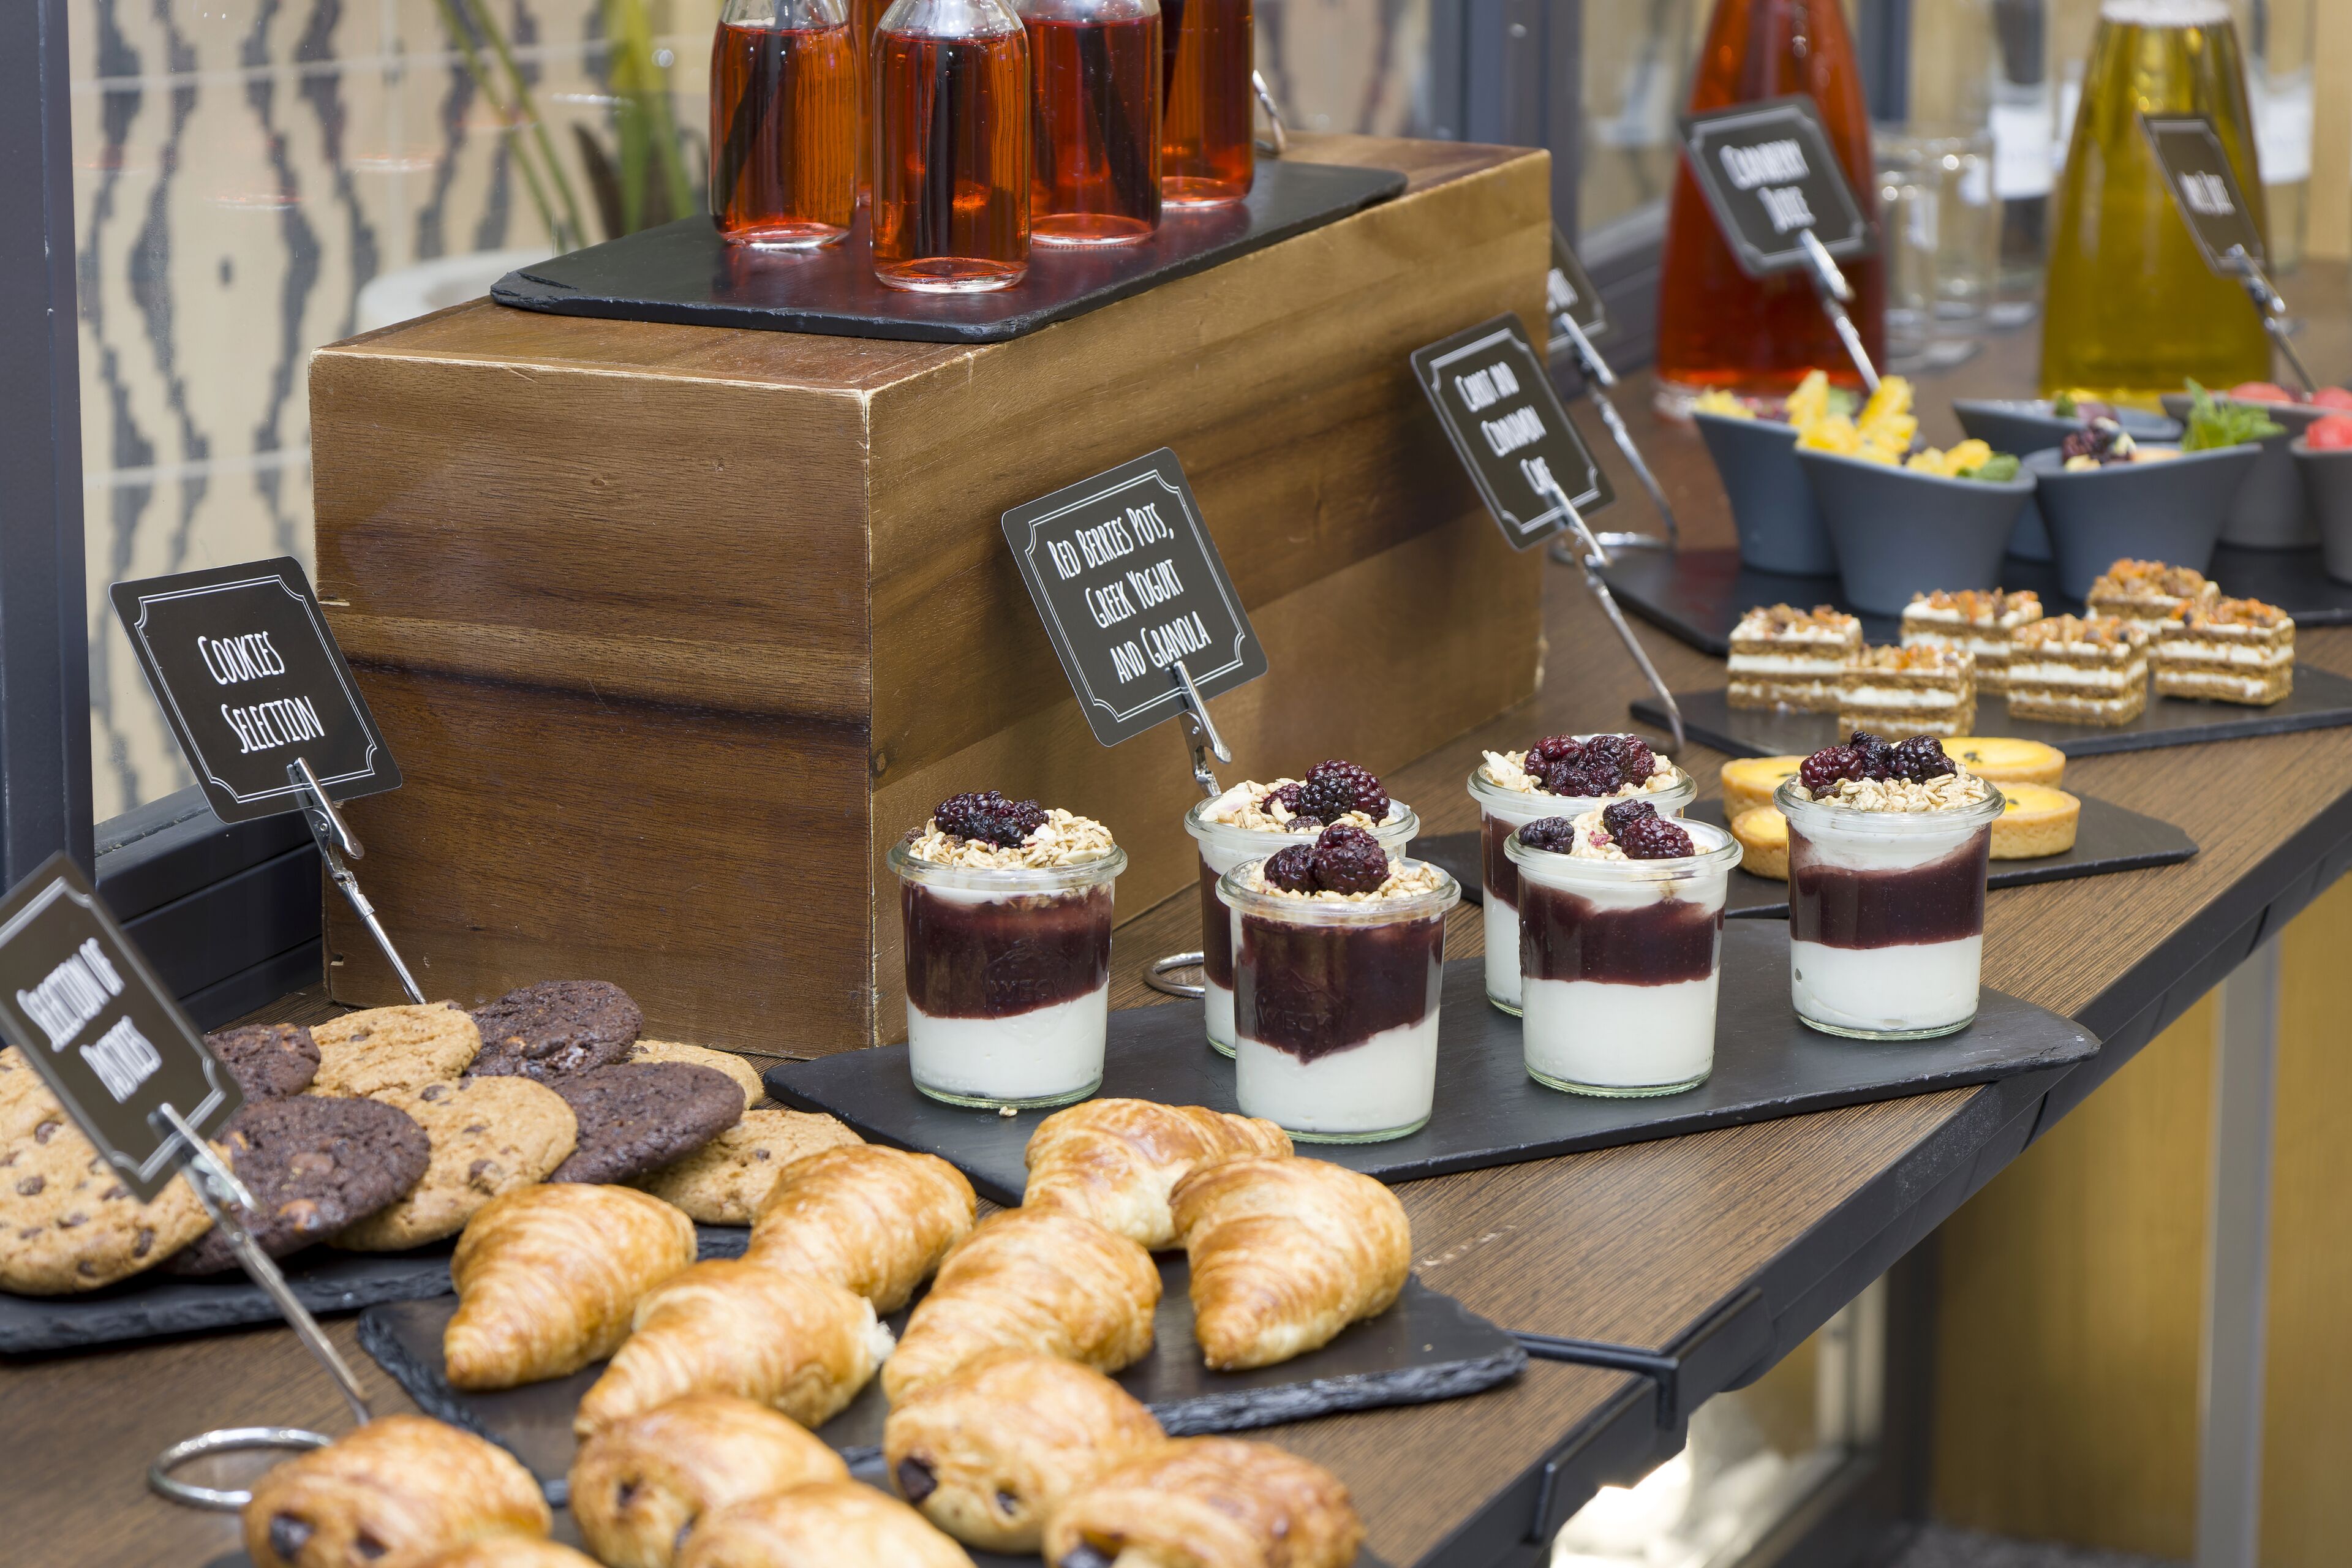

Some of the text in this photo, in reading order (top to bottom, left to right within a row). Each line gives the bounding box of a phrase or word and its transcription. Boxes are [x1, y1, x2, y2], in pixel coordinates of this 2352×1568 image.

[1047, 503, 1174, 581] RED BERRIES POTS,
[1085, 559, 1184, 628] GREEK YOGURT
[197, 631, 285, 685] COOKIES
[1110, 611, 1212, 684] AND GRANOLA
[221, 696, 325, 754] SELECTION
[79, 937, 124, 996] OF
[989, 978, 1065, 1001] WECK
